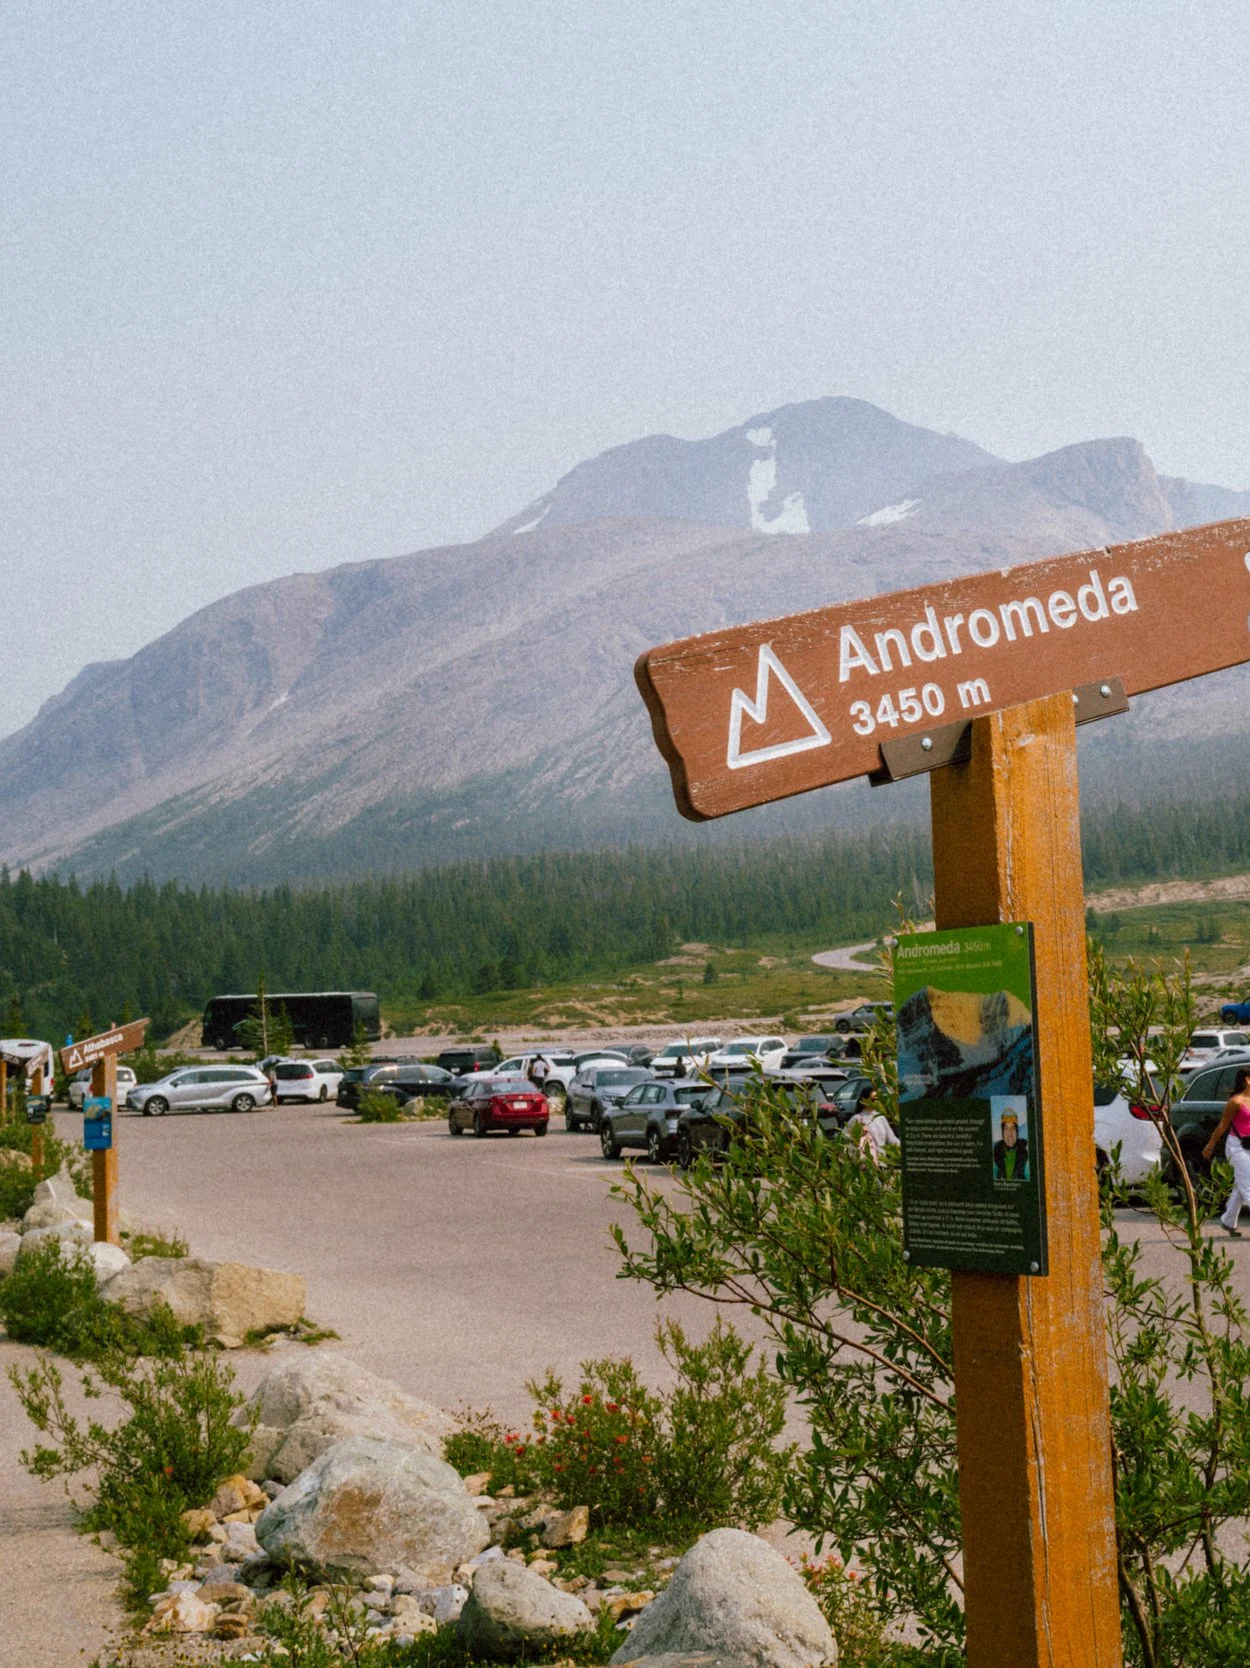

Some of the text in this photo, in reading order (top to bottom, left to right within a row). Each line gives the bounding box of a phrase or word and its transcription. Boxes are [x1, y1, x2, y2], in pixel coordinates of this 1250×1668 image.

[839, 569, 1139, 683] Andromeda
[849, 677, 992, 736] 3450 m
[897, 941, 960, 959] Andromeda
[83, 1033, 124, 1055] Athabasca
